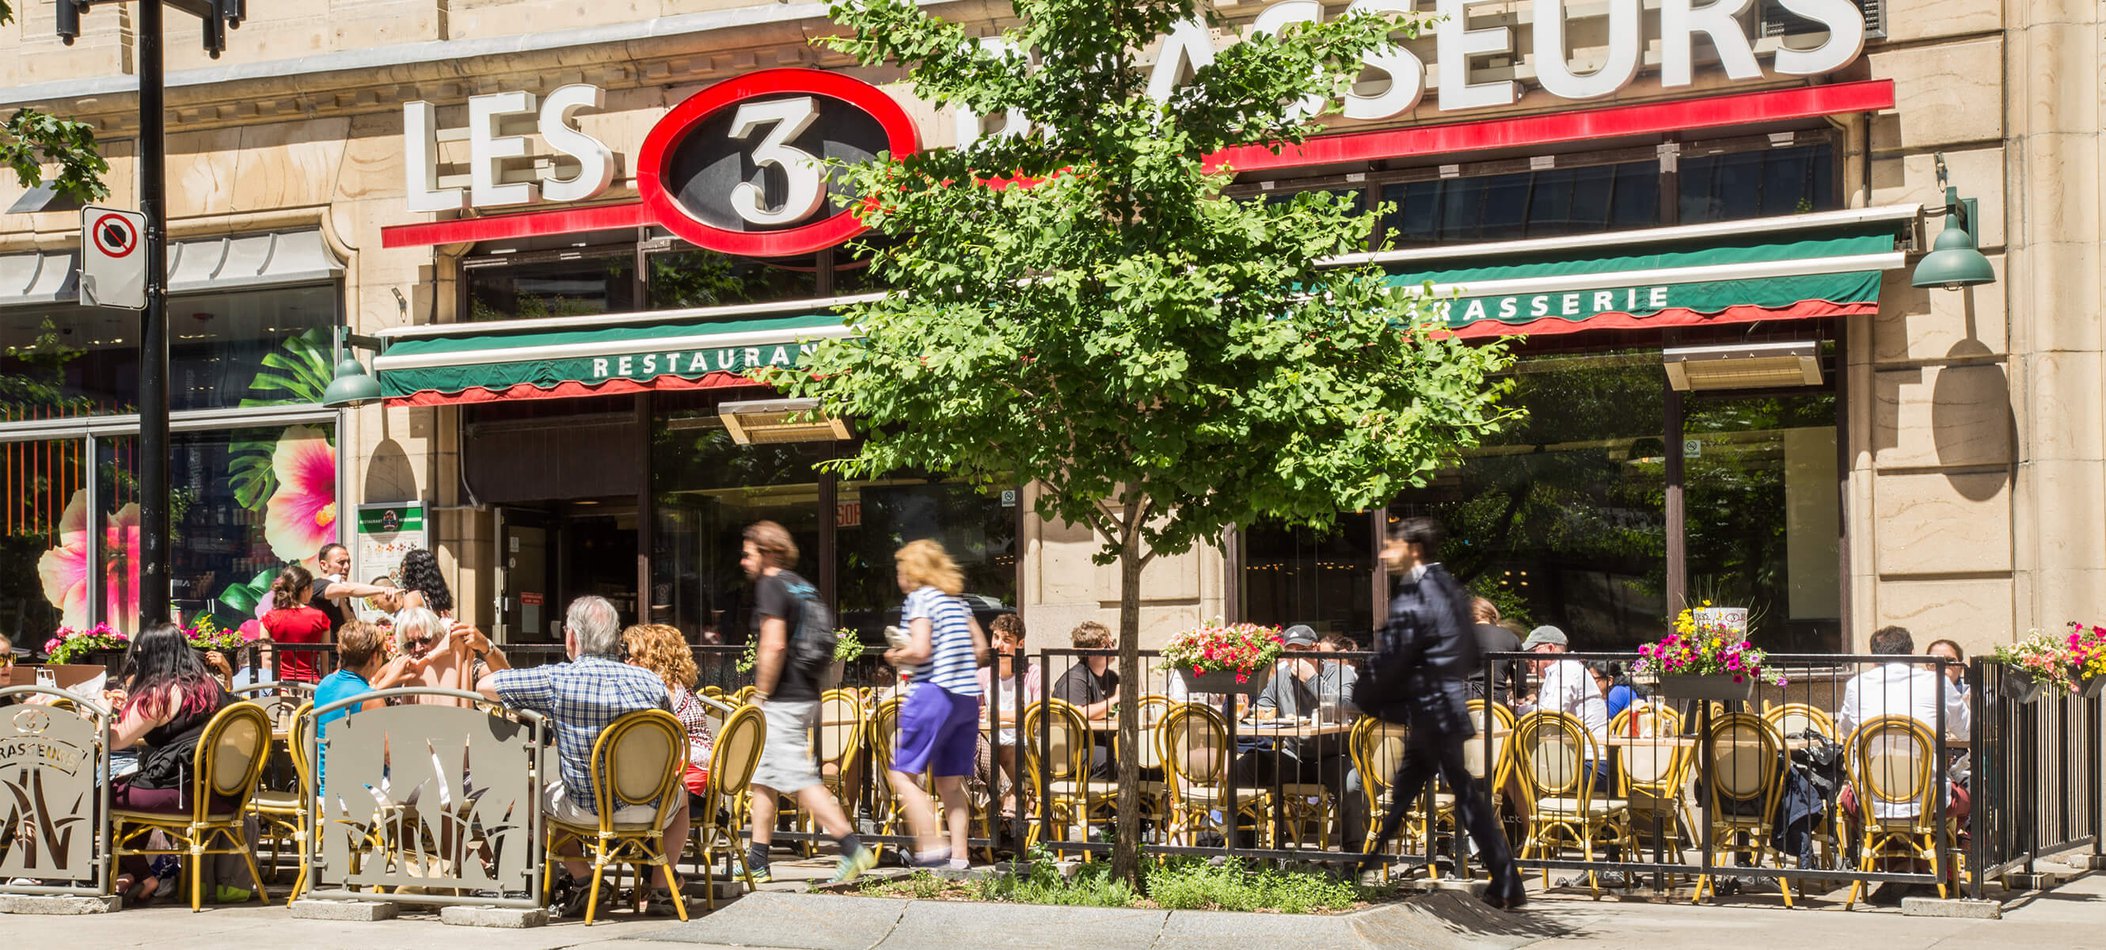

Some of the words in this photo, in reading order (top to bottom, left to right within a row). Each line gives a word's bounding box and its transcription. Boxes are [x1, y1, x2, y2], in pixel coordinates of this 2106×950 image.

[403, 83, 614, 212] LES
[727, 96, 837, 225] 3
[953, 0, 1868, 154] BASSEURS
[592, 344, 838, 378] RESTAURAN
